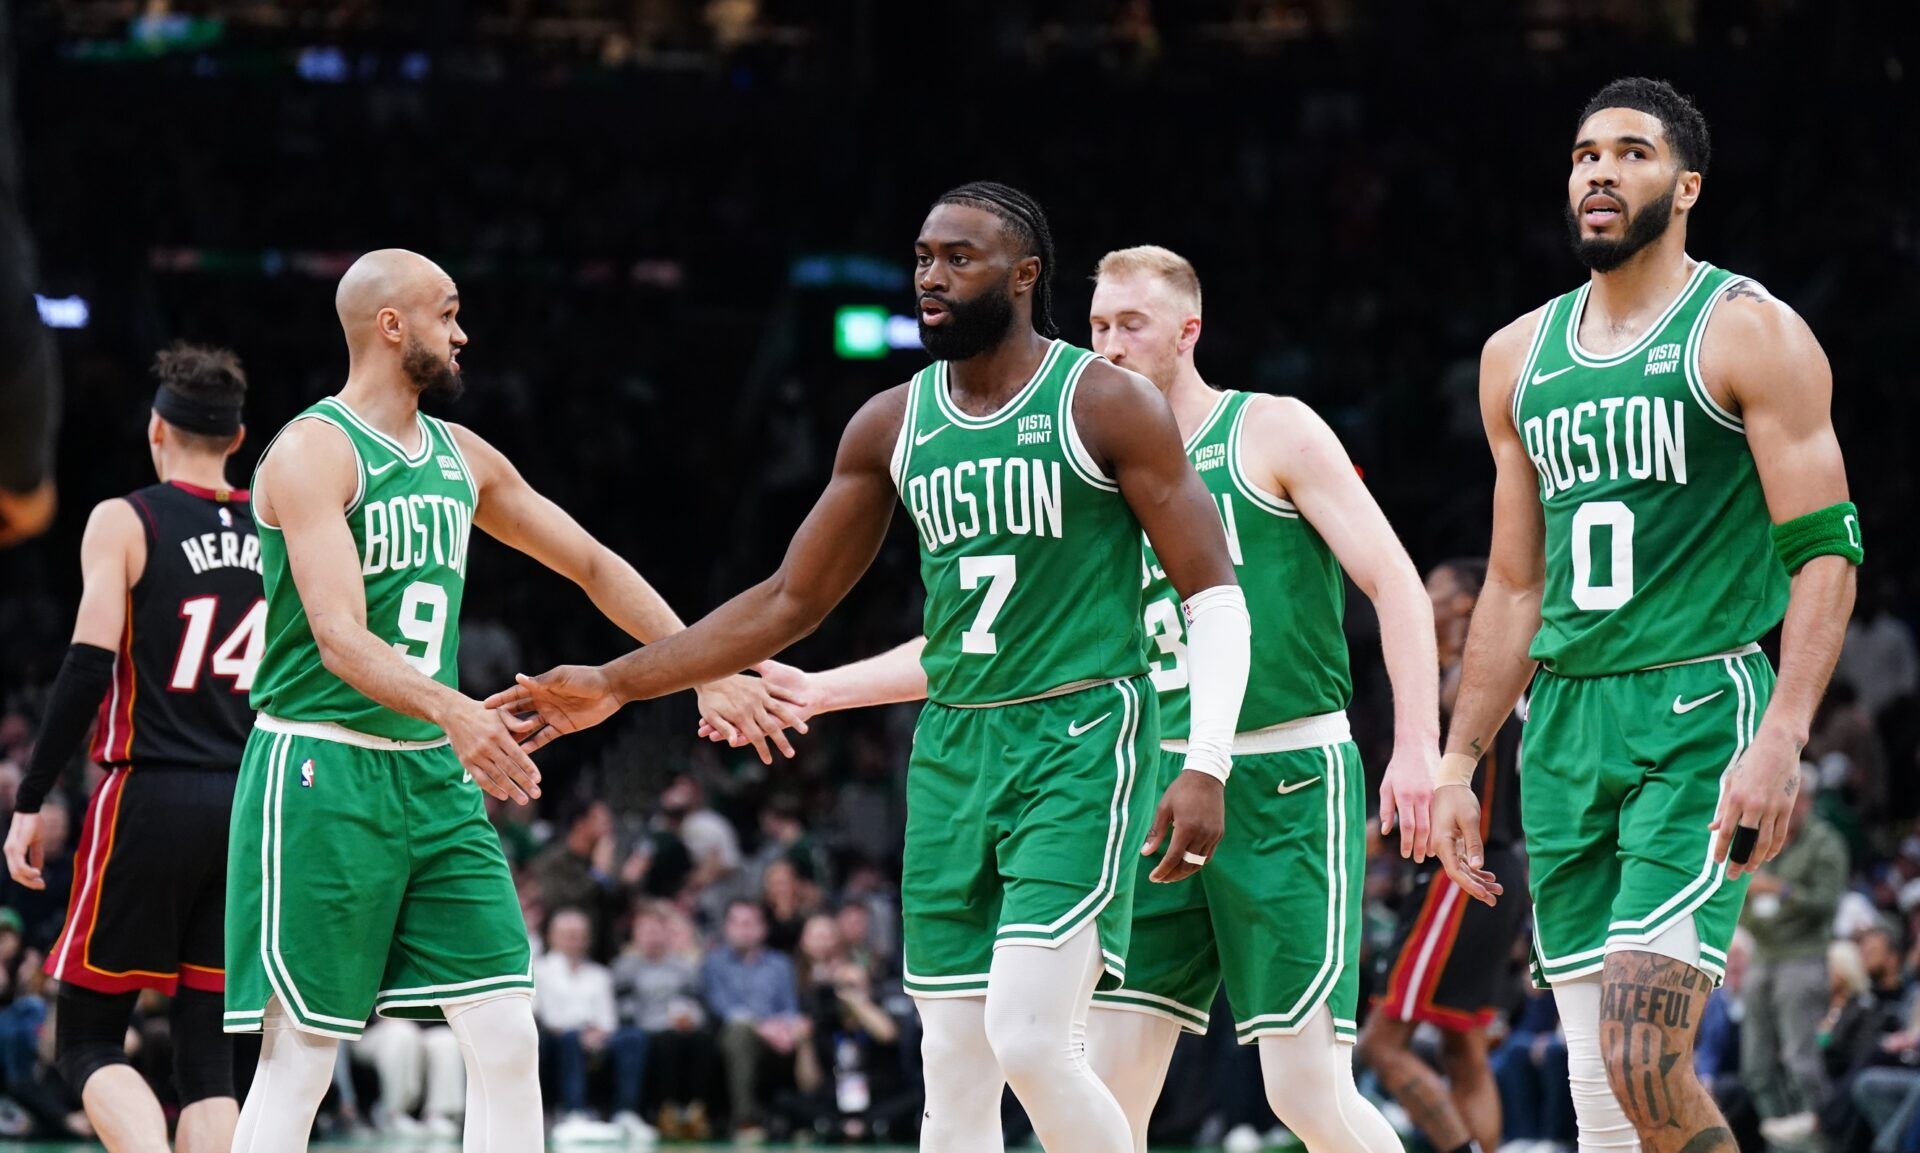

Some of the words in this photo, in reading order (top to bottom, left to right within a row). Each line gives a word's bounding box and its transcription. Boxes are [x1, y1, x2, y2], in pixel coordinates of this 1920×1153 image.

[1644, 360, 1680, 376] PRINT
[1646, 343, 1681, 363] VISTA
[1017, 414, 1052, 431] VISTA
[1017, 430, 1052, 446] PRINT
[1195, 443, 1226, 463] VISTA
[1523, 396, 1688, 501] BOSTON
[1195, 456, 1226, 472] PRINT
[362, 494, 472, 580] BOSTON
[908, 457, 1063, 553] BOSTON
[180, 531, 264, 576] HERR
[1570, 501, 1635, 611] 0
[391, 580, 449, 678] 9
[958, 554, 1018, 655] 7
[167, 594, 269, 693] 14
